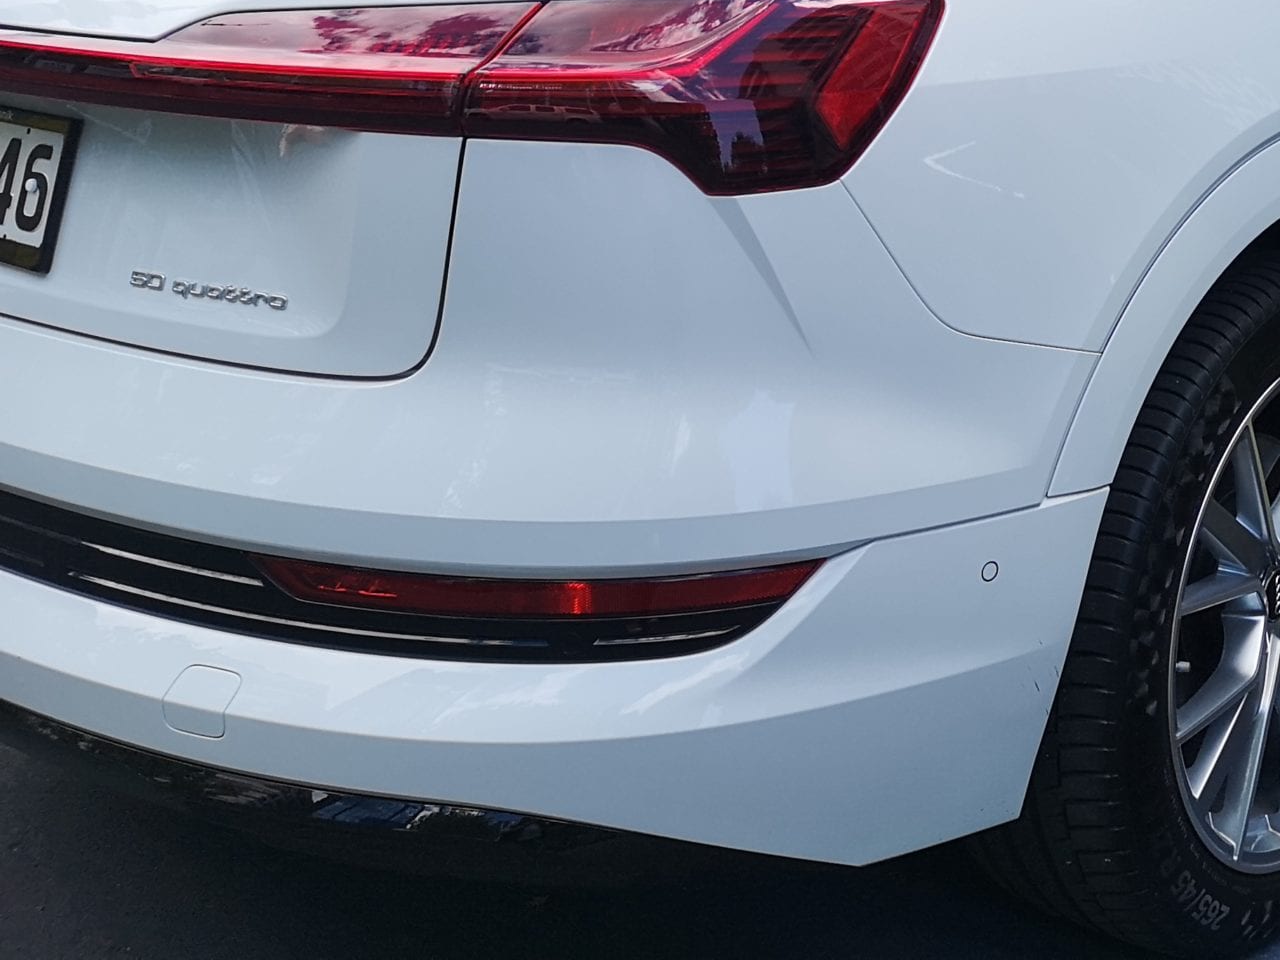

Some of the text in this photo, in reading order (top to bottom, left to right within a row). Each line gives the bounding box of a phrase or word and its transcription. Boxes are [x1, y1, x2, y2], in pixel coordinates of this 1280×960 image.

[129, 271, 289, 311] 50 quattro
[1169, 869, 1231, 932] 265/45
